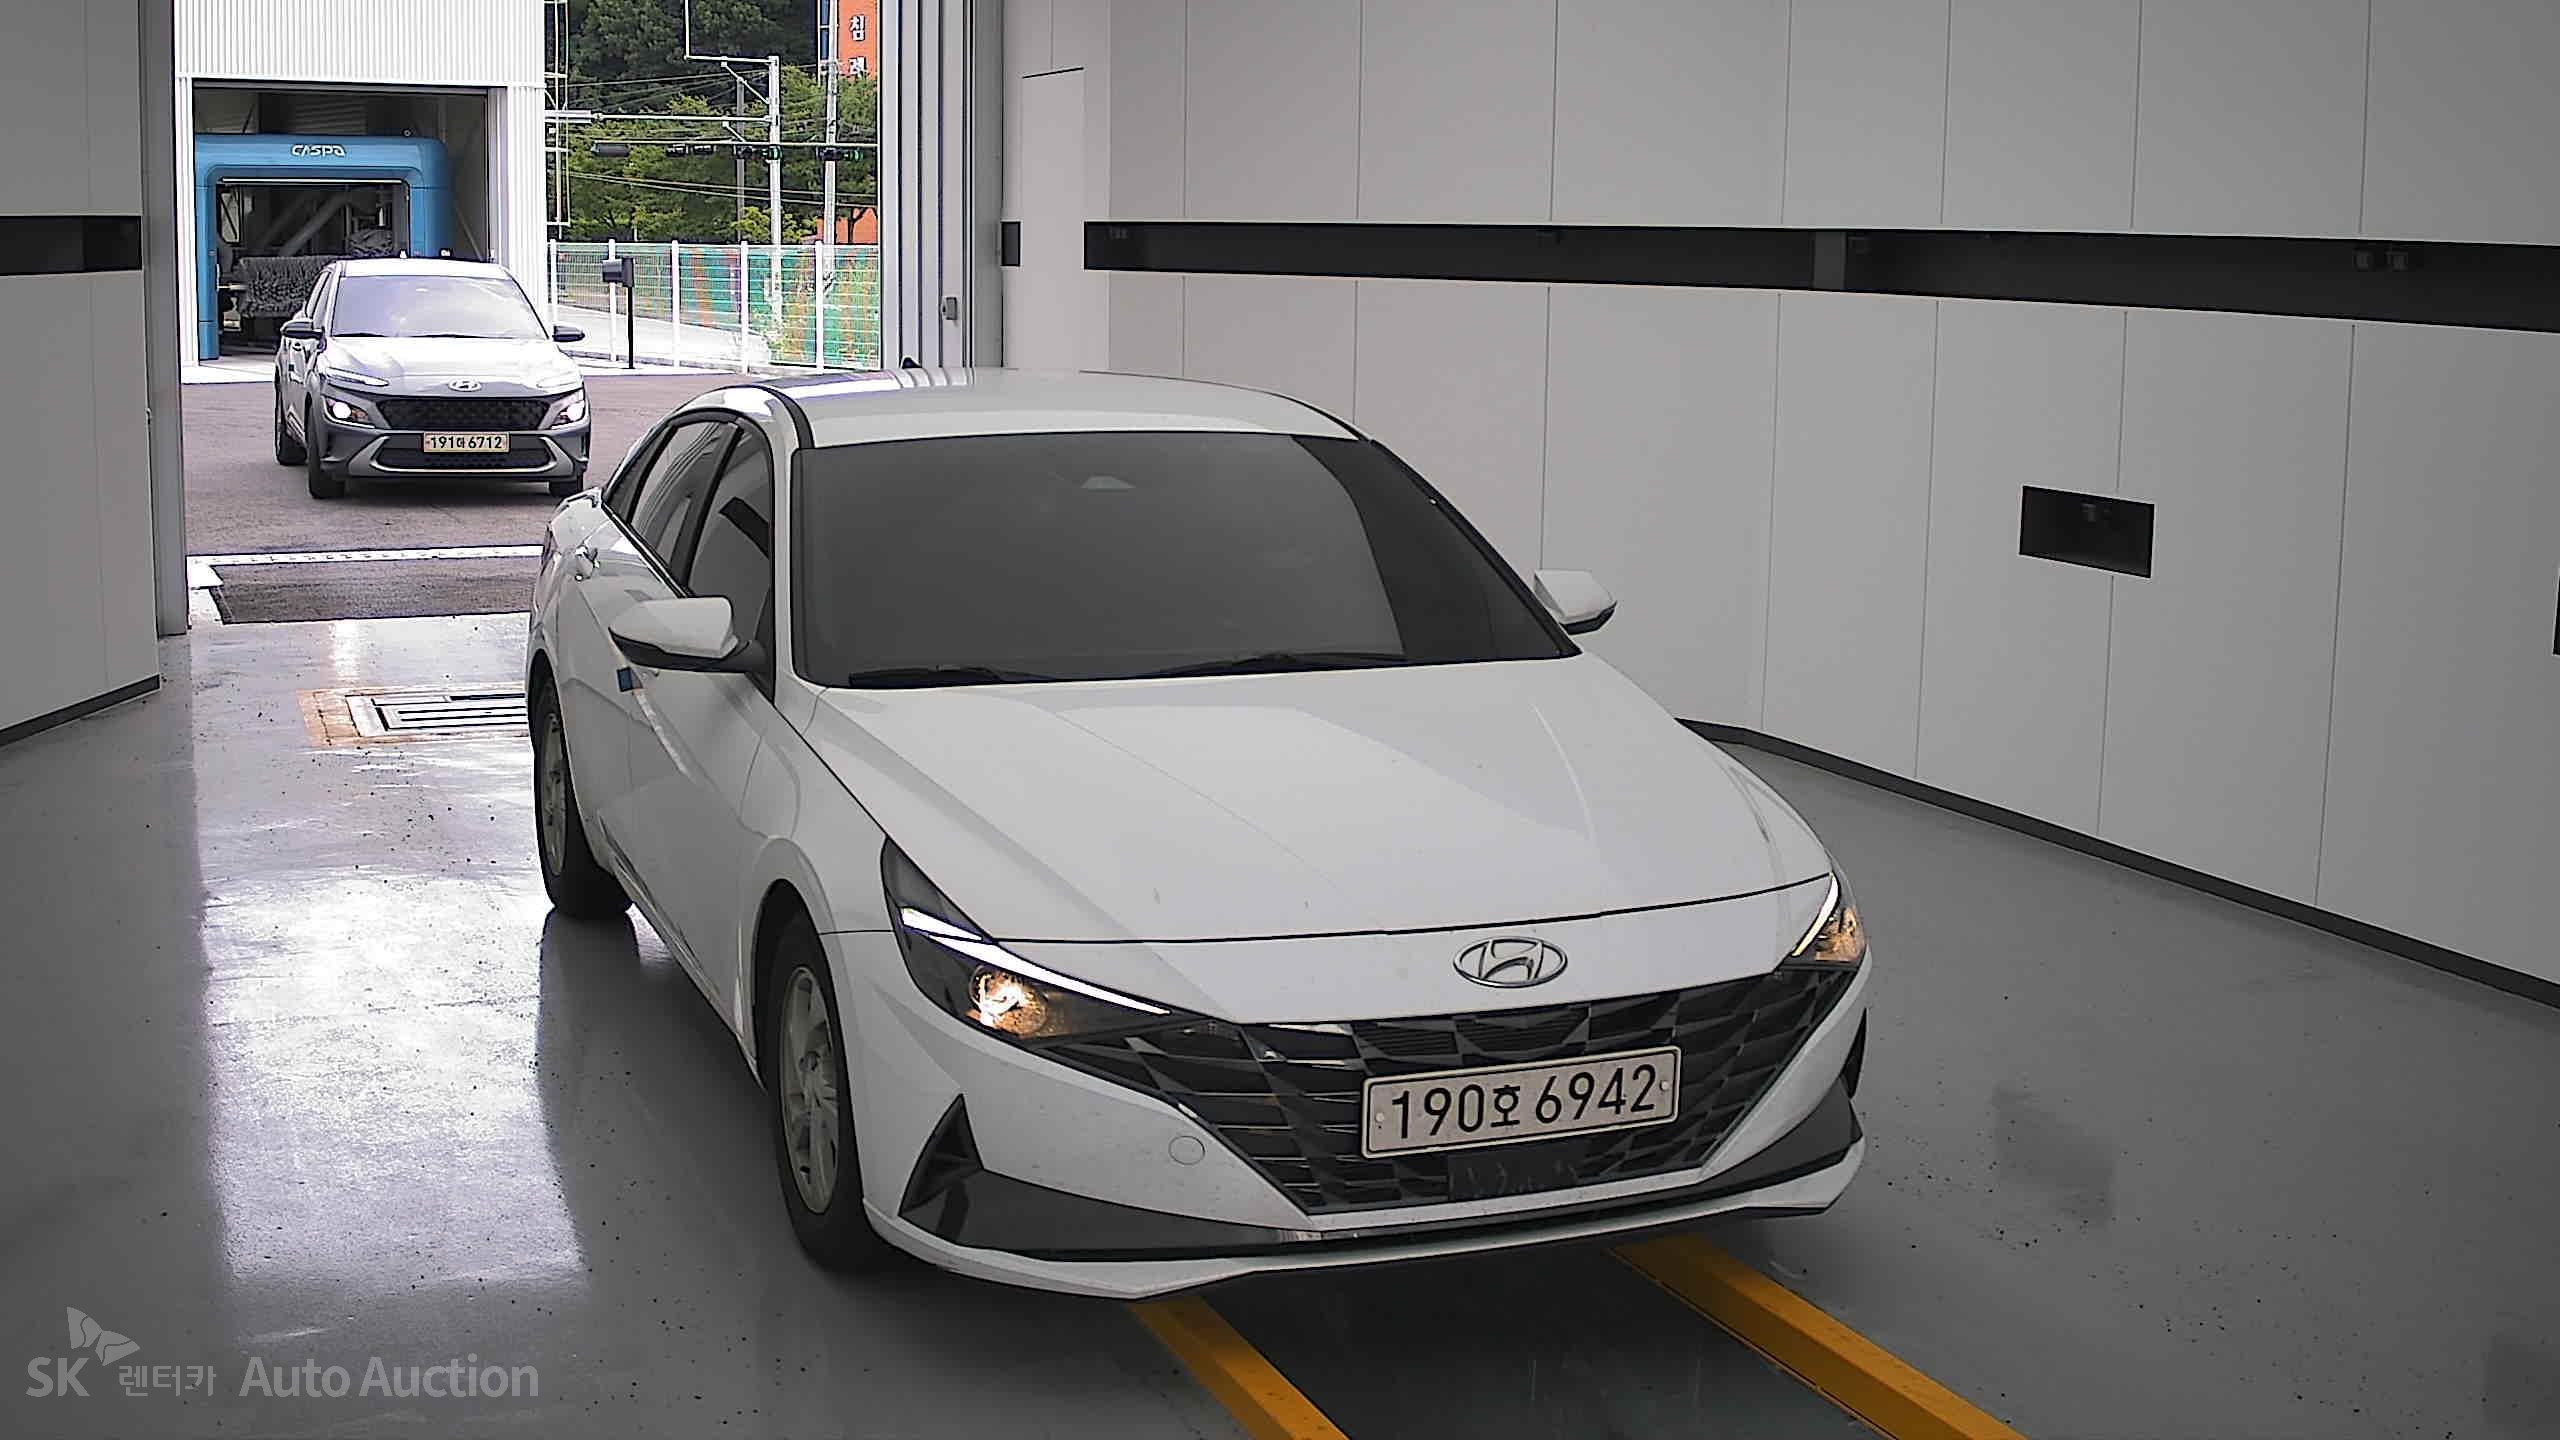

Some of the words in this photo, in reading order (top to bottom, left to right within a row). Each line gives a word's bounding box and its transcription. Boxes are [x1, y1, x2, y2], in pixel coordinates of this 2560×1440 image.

[468, 436, 502, 448] 6712
[1392, 1083, 1520, 1139] 190호
[1535, 1064, 1657, 1124] 6942
